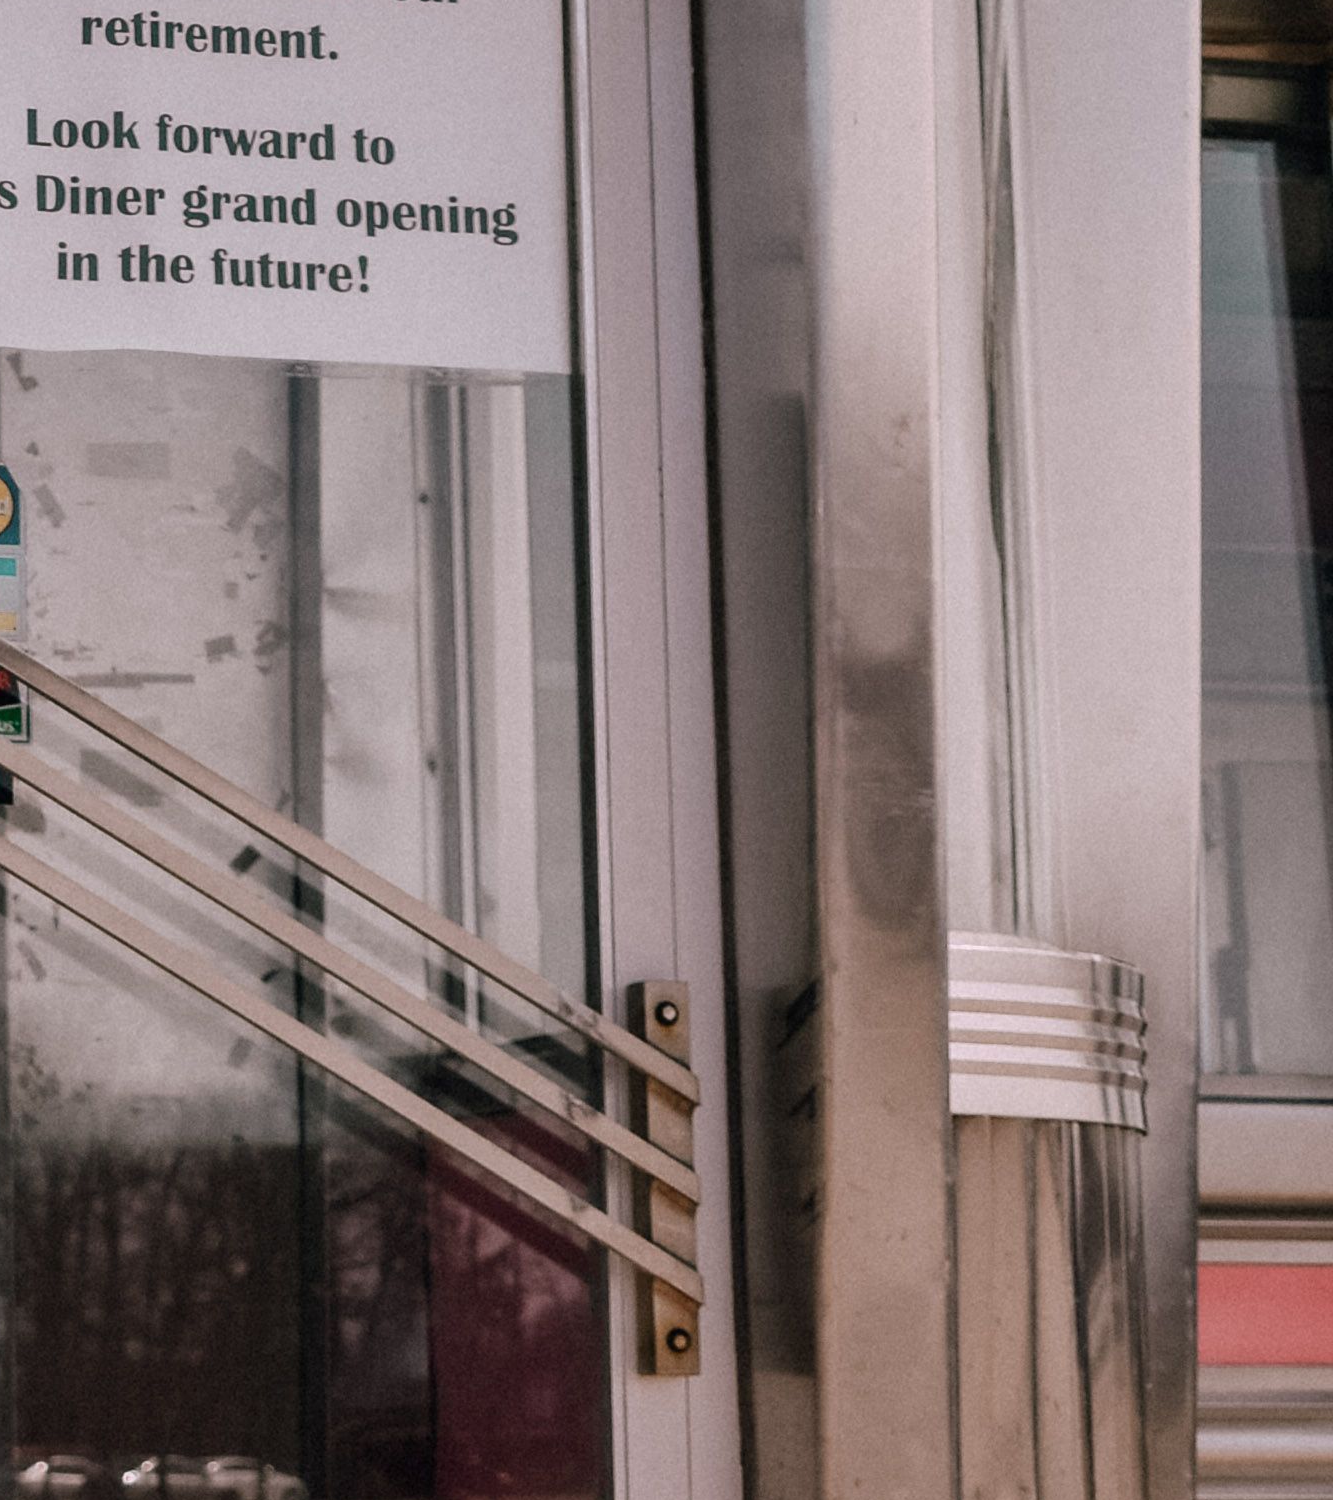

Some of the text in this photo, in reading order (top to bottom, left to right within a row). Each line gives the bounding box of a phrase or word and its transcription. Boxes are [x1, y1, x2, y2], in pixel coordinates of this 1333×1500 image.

[82, 11, 338, 60] retirement.
[27, 109, 395, 165] Look forward to
[37, 175, 165, 215] Diner
[183, 185, 316, 228] grand
[337, 196, 518, 245] opening
[58, 242, 368, 292] in the future!
